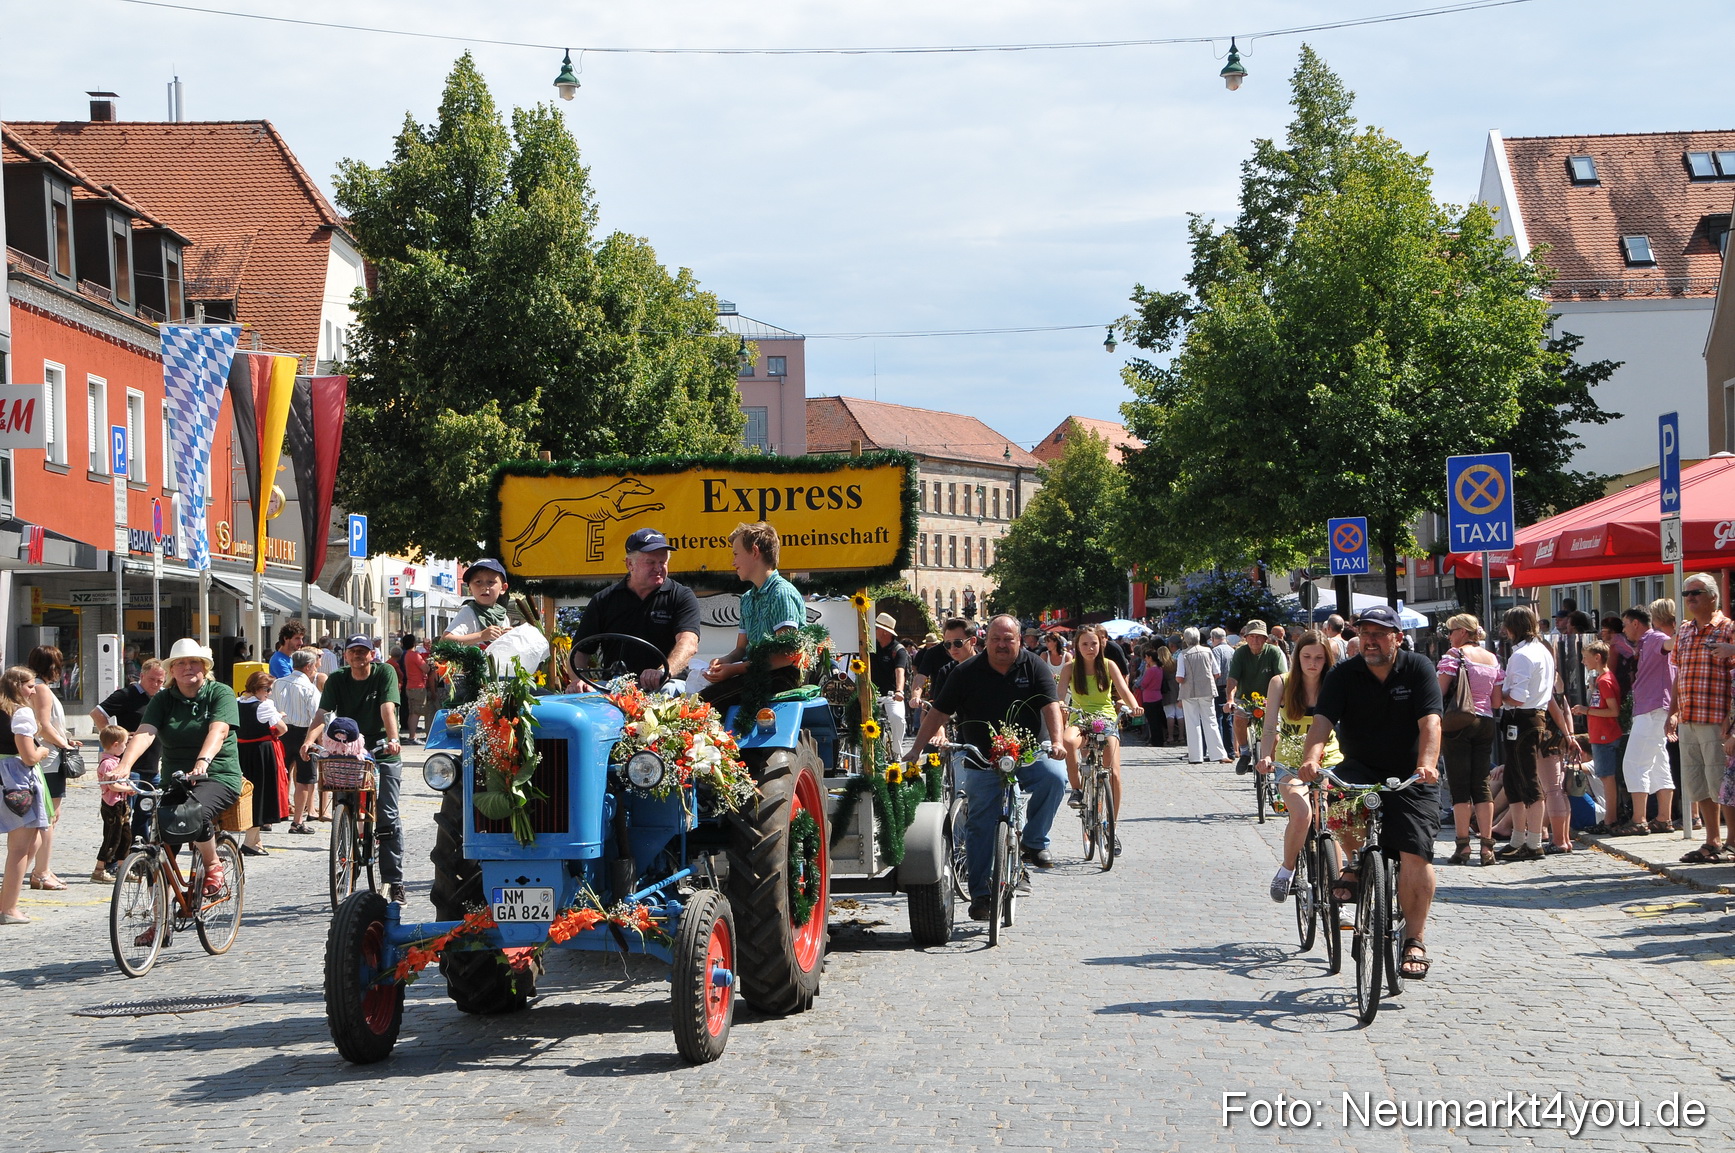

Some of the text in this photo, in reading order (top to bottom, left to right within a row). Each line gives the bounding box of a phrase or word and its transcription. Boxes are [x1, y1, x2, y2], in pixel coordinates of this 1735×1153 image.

[115, 432, 124, 468] P
[1662, 424, 1675, 480] P
[700, 478, 863, 522] Express
[353, 520, 363, 552] P
[1455, 522, 1507, 543] TAXI
[1333, 557, 1365, 570] TAXI
[73, 593, 92, 602] NZ
[504, 890, 524, 904] NM
[497, 905, 550, 920] GA 824
